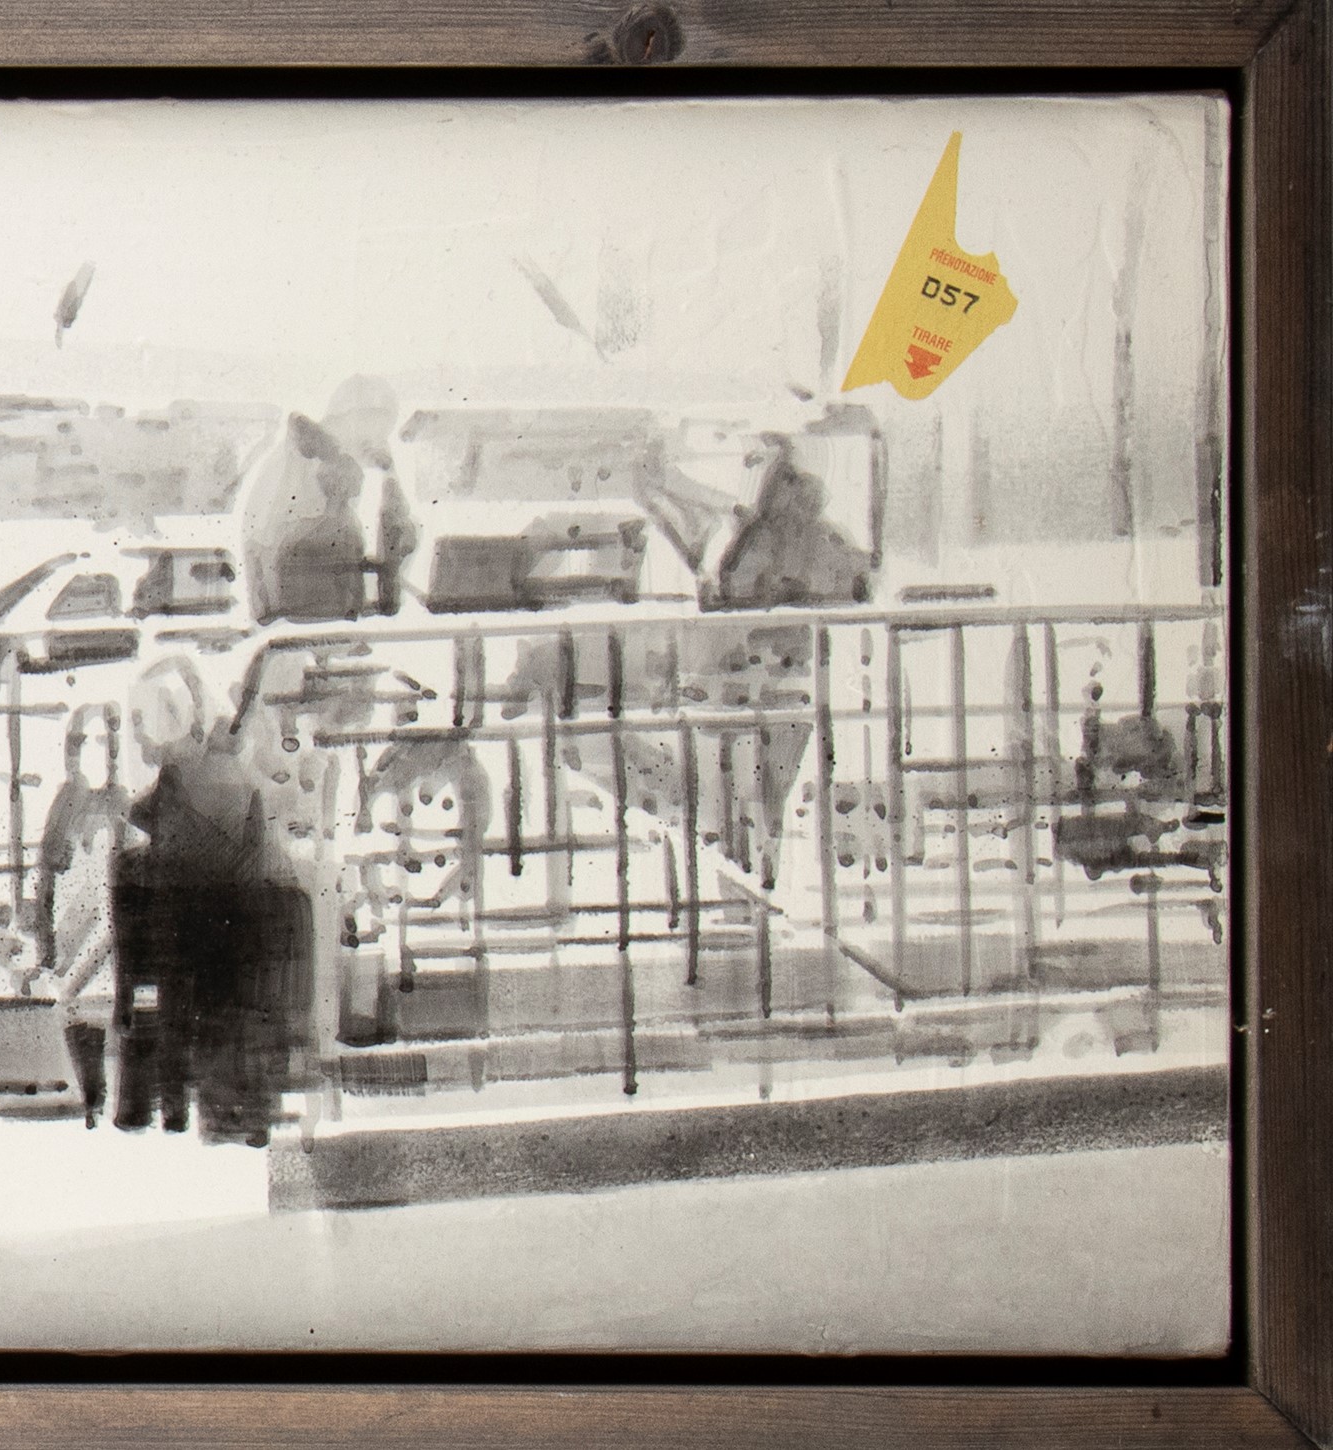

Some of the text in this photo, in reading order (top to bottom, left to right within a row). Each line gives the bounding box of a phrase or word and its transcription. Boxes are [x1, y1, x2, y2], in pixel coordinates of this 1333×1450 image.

[929, 248, 997, 285] PRENOTAZIONE
[921, 275, 980, 314] D57
[912, 326, 953, 353] TIRARE
